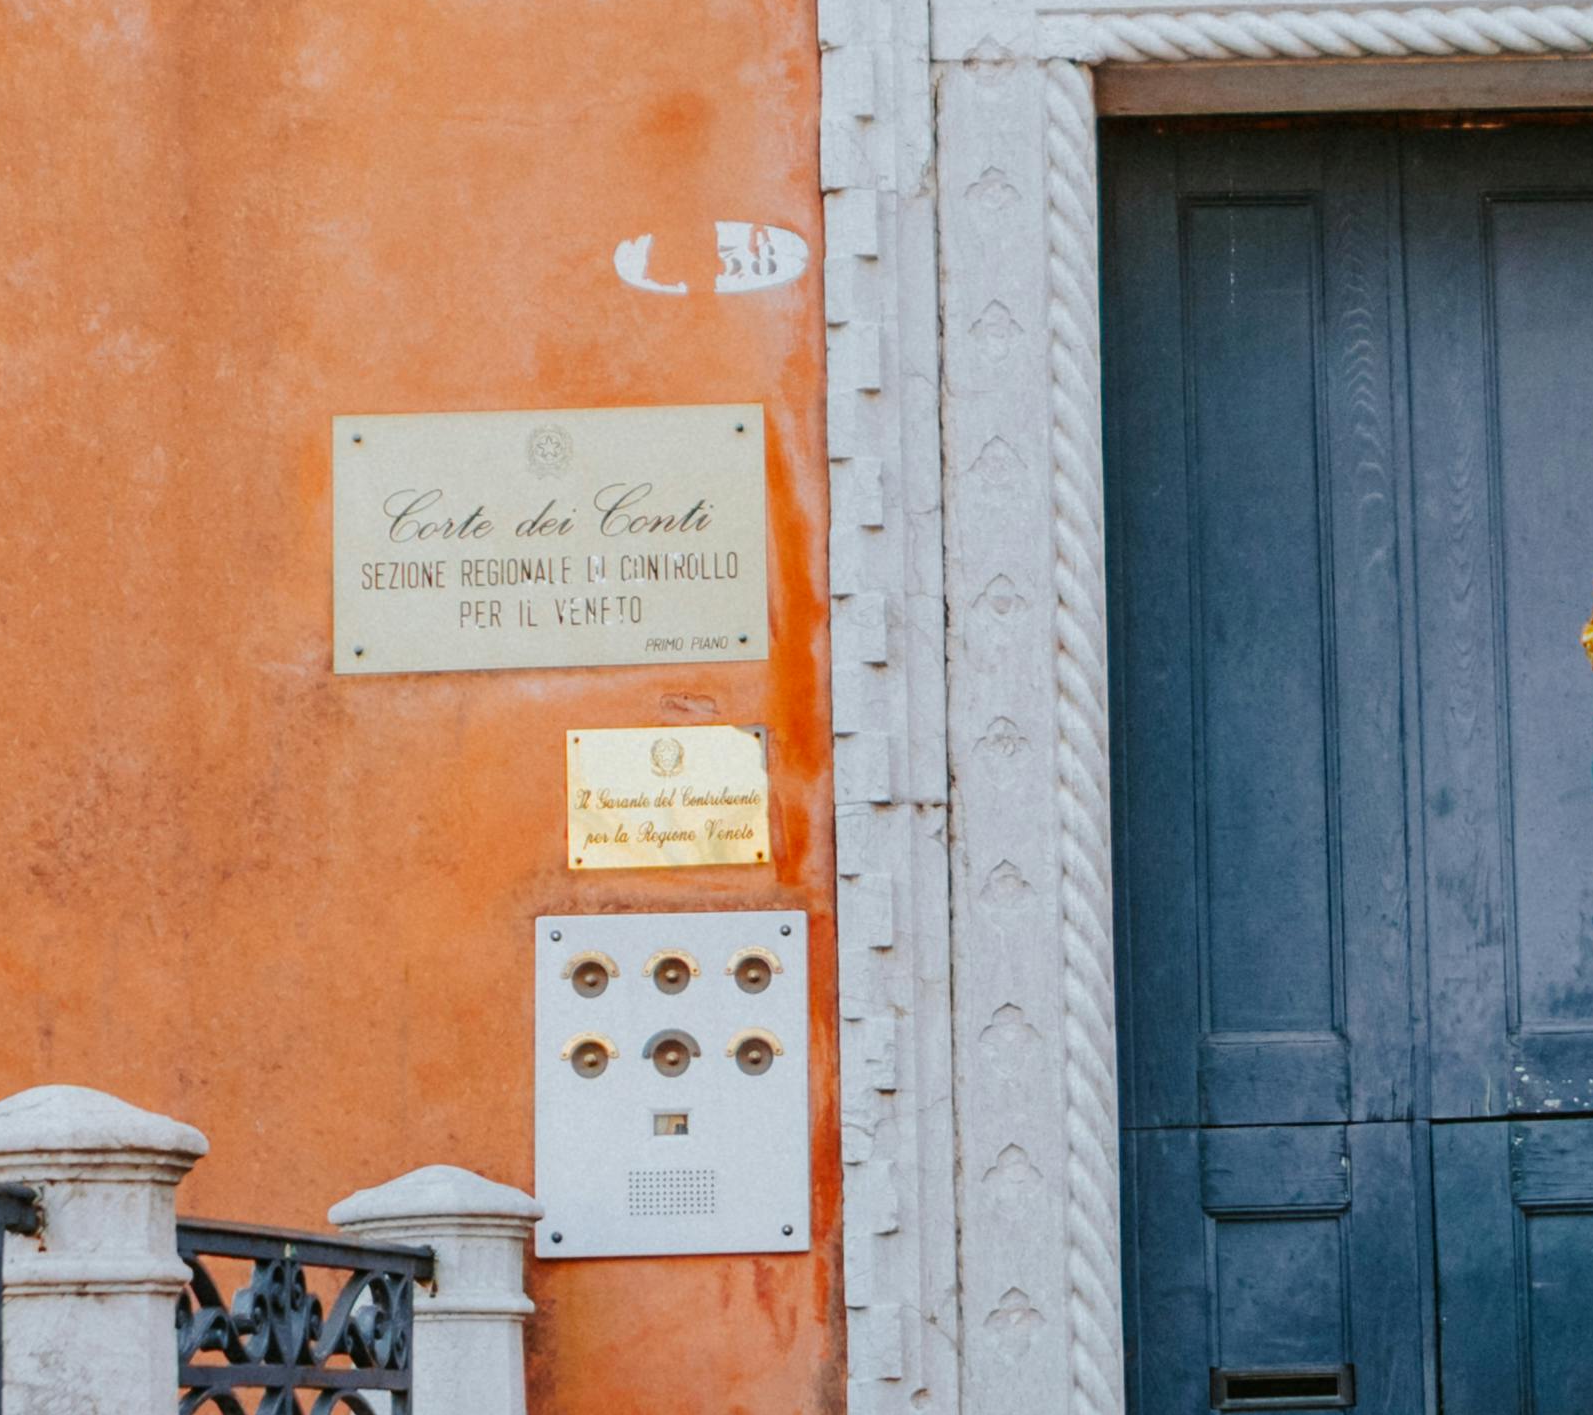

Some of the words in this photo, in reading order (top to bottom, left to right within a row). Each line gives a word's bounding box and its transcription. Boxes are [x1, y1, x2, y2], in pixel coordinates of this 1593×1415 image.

[383, 488, 496, 544] Corte
[515, 498, 578, 538] dei
[593, 482, 715, 538] Conti
[360, 560, 447, 591] SEZIONE
[460, 555, 572, 588] REGIONALE
[586, 554, 608, 585] DI
[619, 550, 740, 584] CONTROLLO
[459, 599, 502, 629] PER
[517, 599, 538, 628] IL
[554, 595, 643, 627] VENETO
[644, 636, 685, 653] PRIMO
[690, 635, 729, 651] PIANO
[595, 787, 651, 810] Garante
[653, 787, 677, 809] del
[680, 785, 763, 808] Contribuente
[582, 831, 610, 851] per
[613, 823, 629, 844] la
[635, 820, 697, 850] Regione
[703, 819, 755, 842] Veneto
